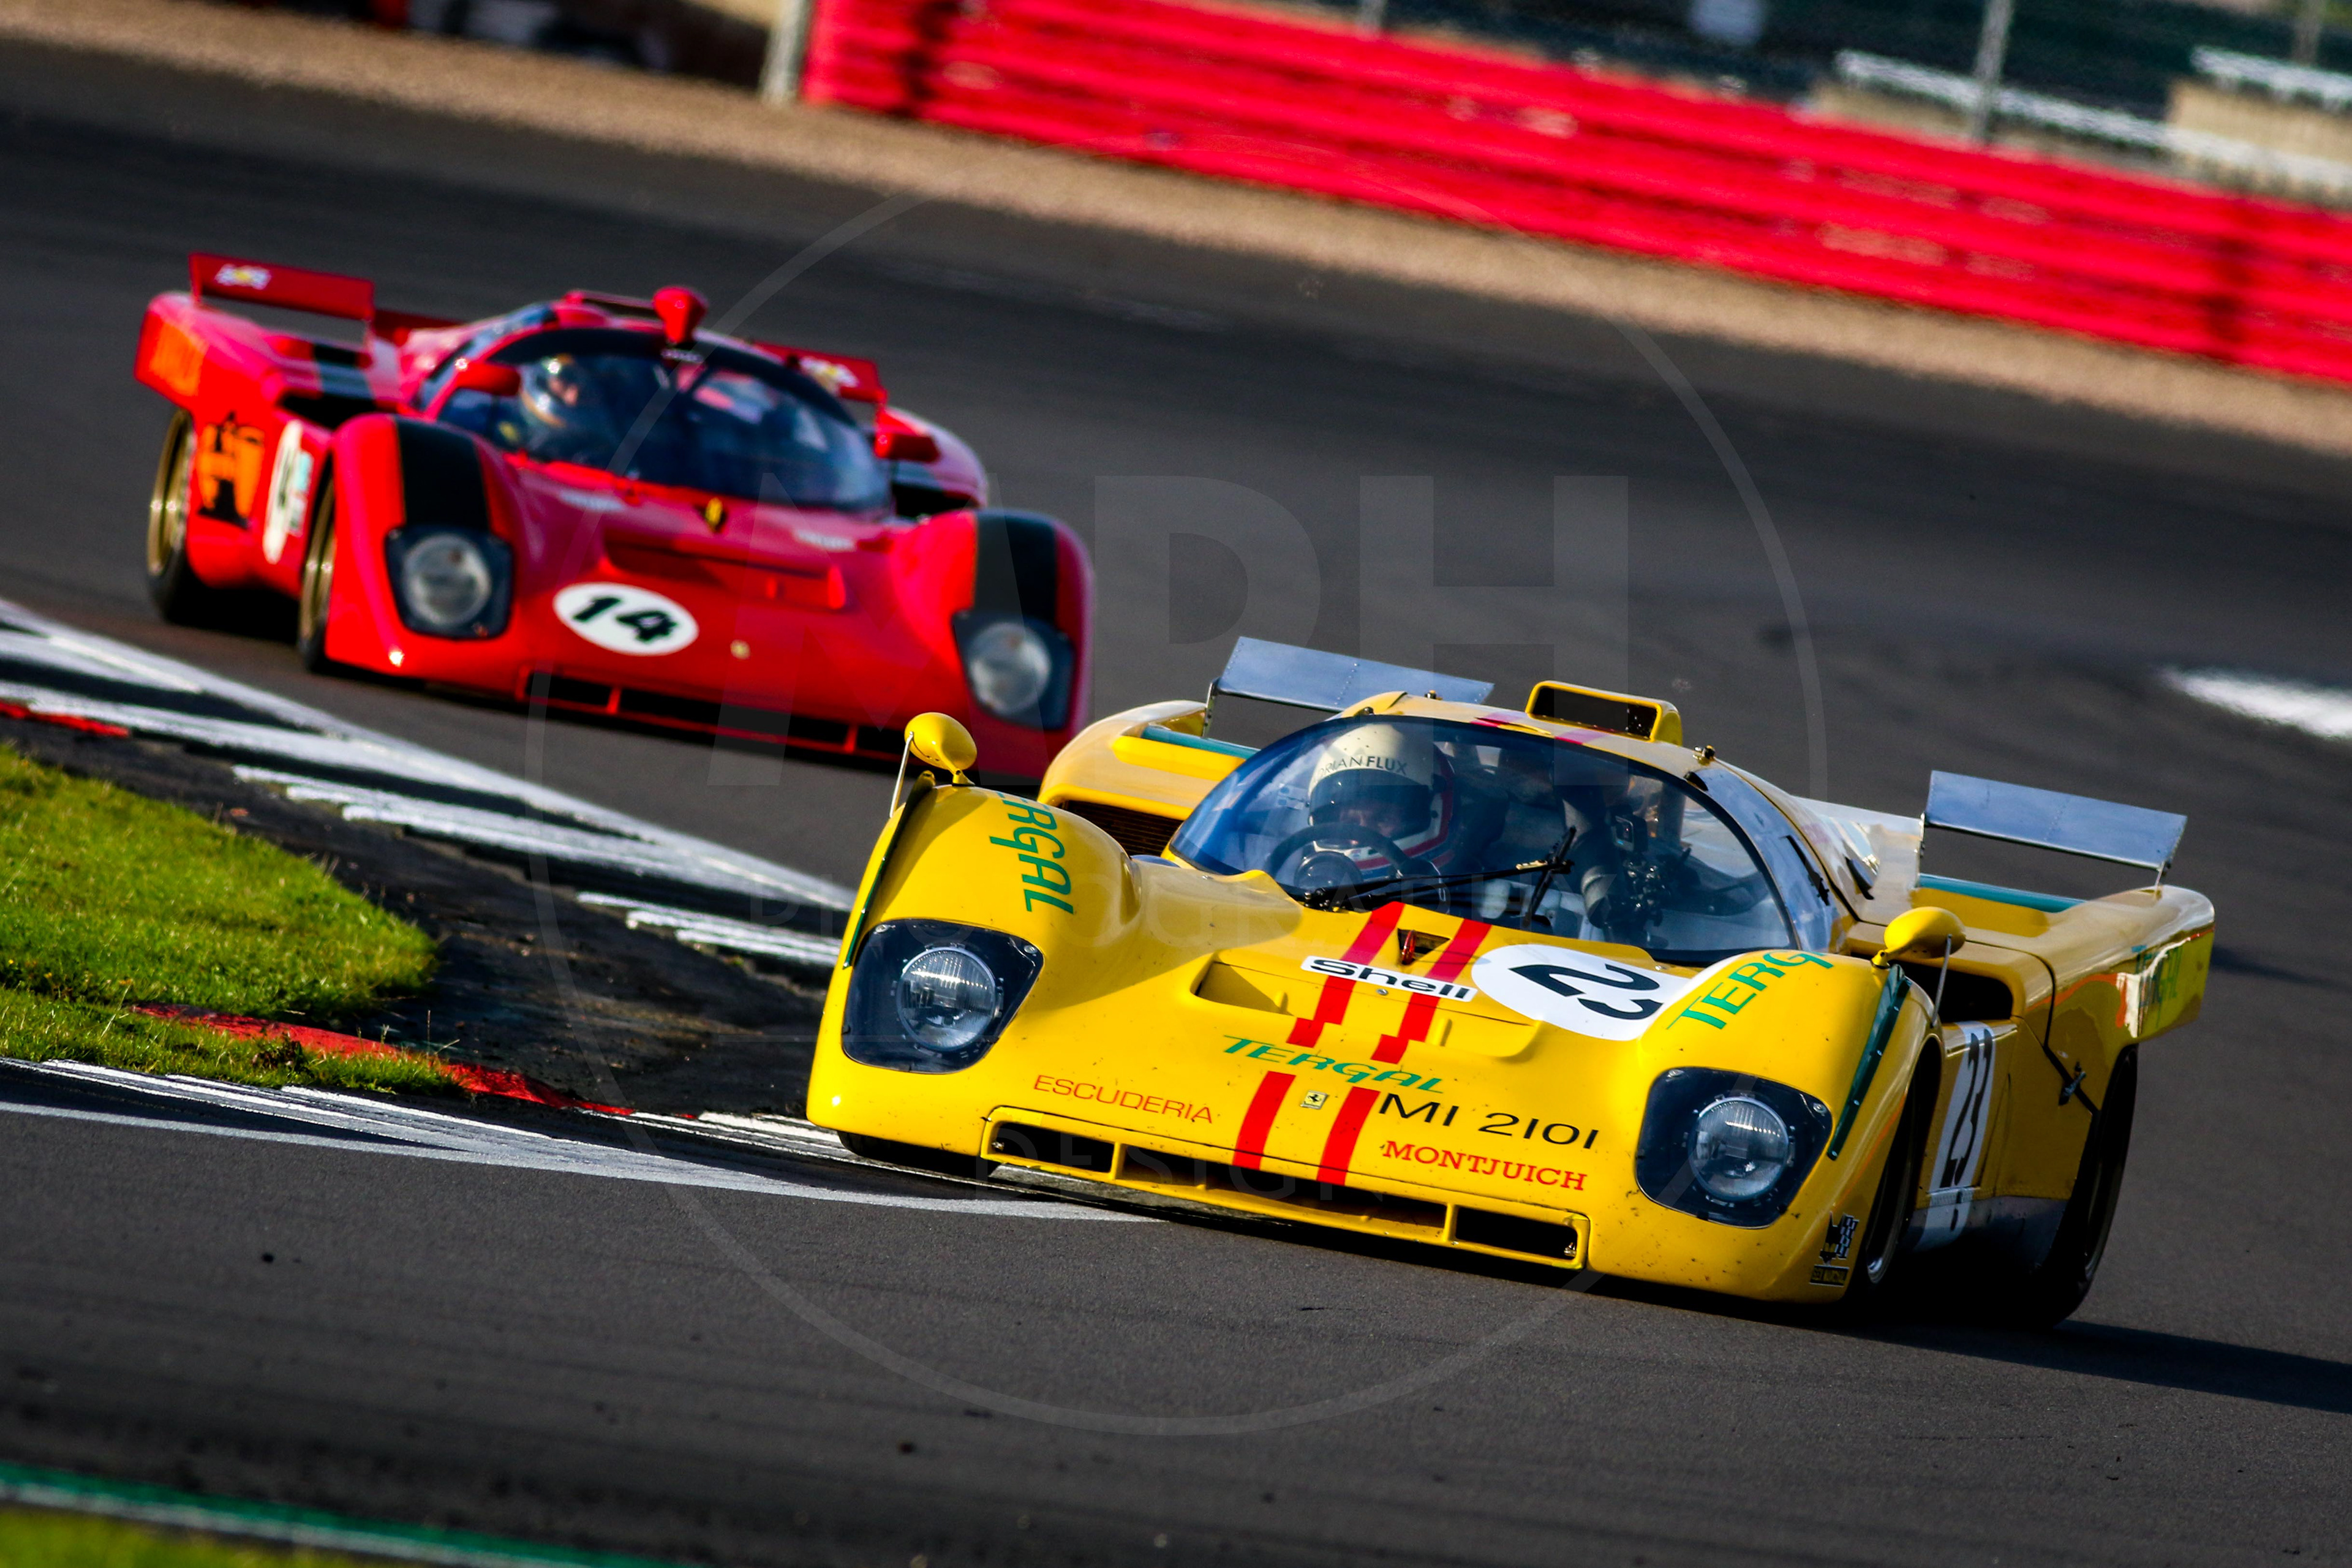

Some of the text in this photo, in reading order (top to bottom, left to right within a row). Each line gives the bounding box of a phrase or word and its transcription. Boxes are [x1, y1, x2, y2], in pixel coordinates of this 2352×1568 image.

[573, 596, 677, 641] 14
[1366, 756, 1408, 775] FLUX
[1310, 959, 1469, 1000] Shell
[1224, 1035, 1443, 1093] TERGAL
[1033, 1074, 1212, 1124] ESCUDERIA
[1379, 1093, 1599, 1150] MI 2101
[1382, 1140, 1587, 1191] MONTJUICH
